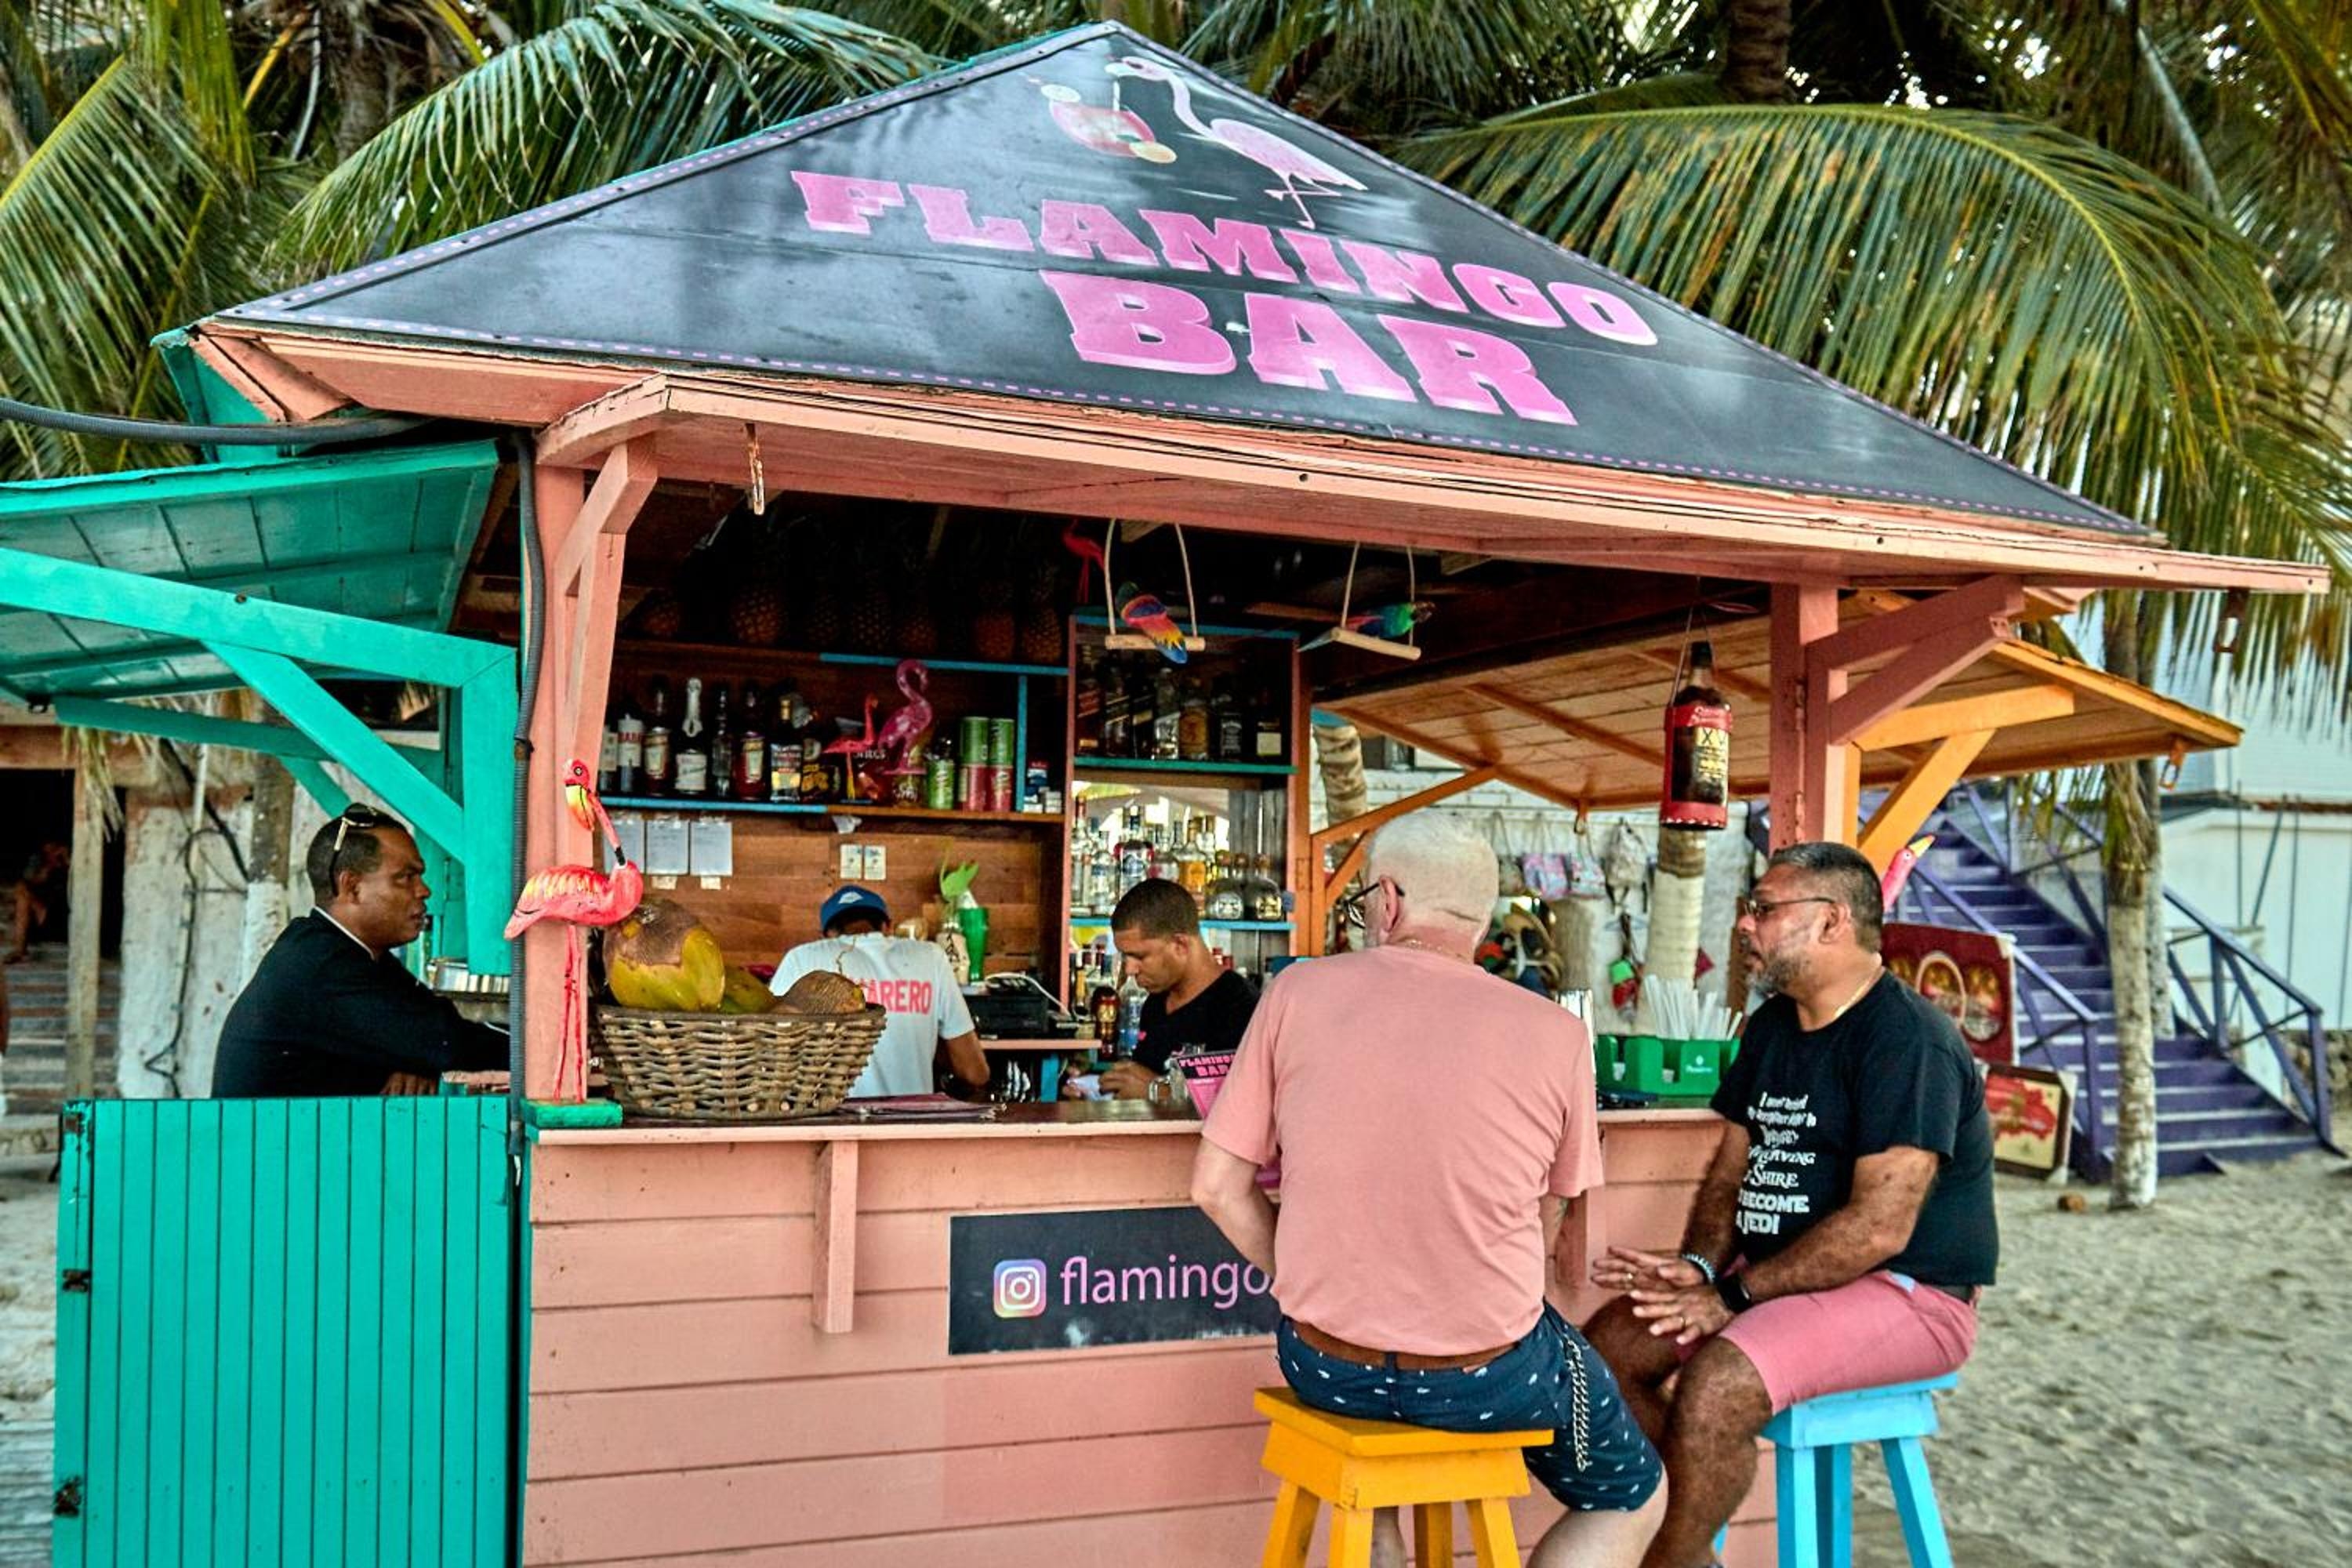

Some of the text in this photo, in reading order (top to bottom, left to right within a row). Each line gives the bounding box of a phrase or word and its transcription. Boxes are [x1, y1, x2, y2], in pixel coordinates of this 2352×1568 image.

[790, 170, 1659, 346] FLAMINGO
[1040, 270, 1578, 425] BAR
[1749, 1164, 1799, 1189] SHIRE
[1742, 1190, 1810, 1213] BECOME
[1742, 1210, 1780, 1235] JEDI
[1060, 1254, 1271, 1310] flamingo
